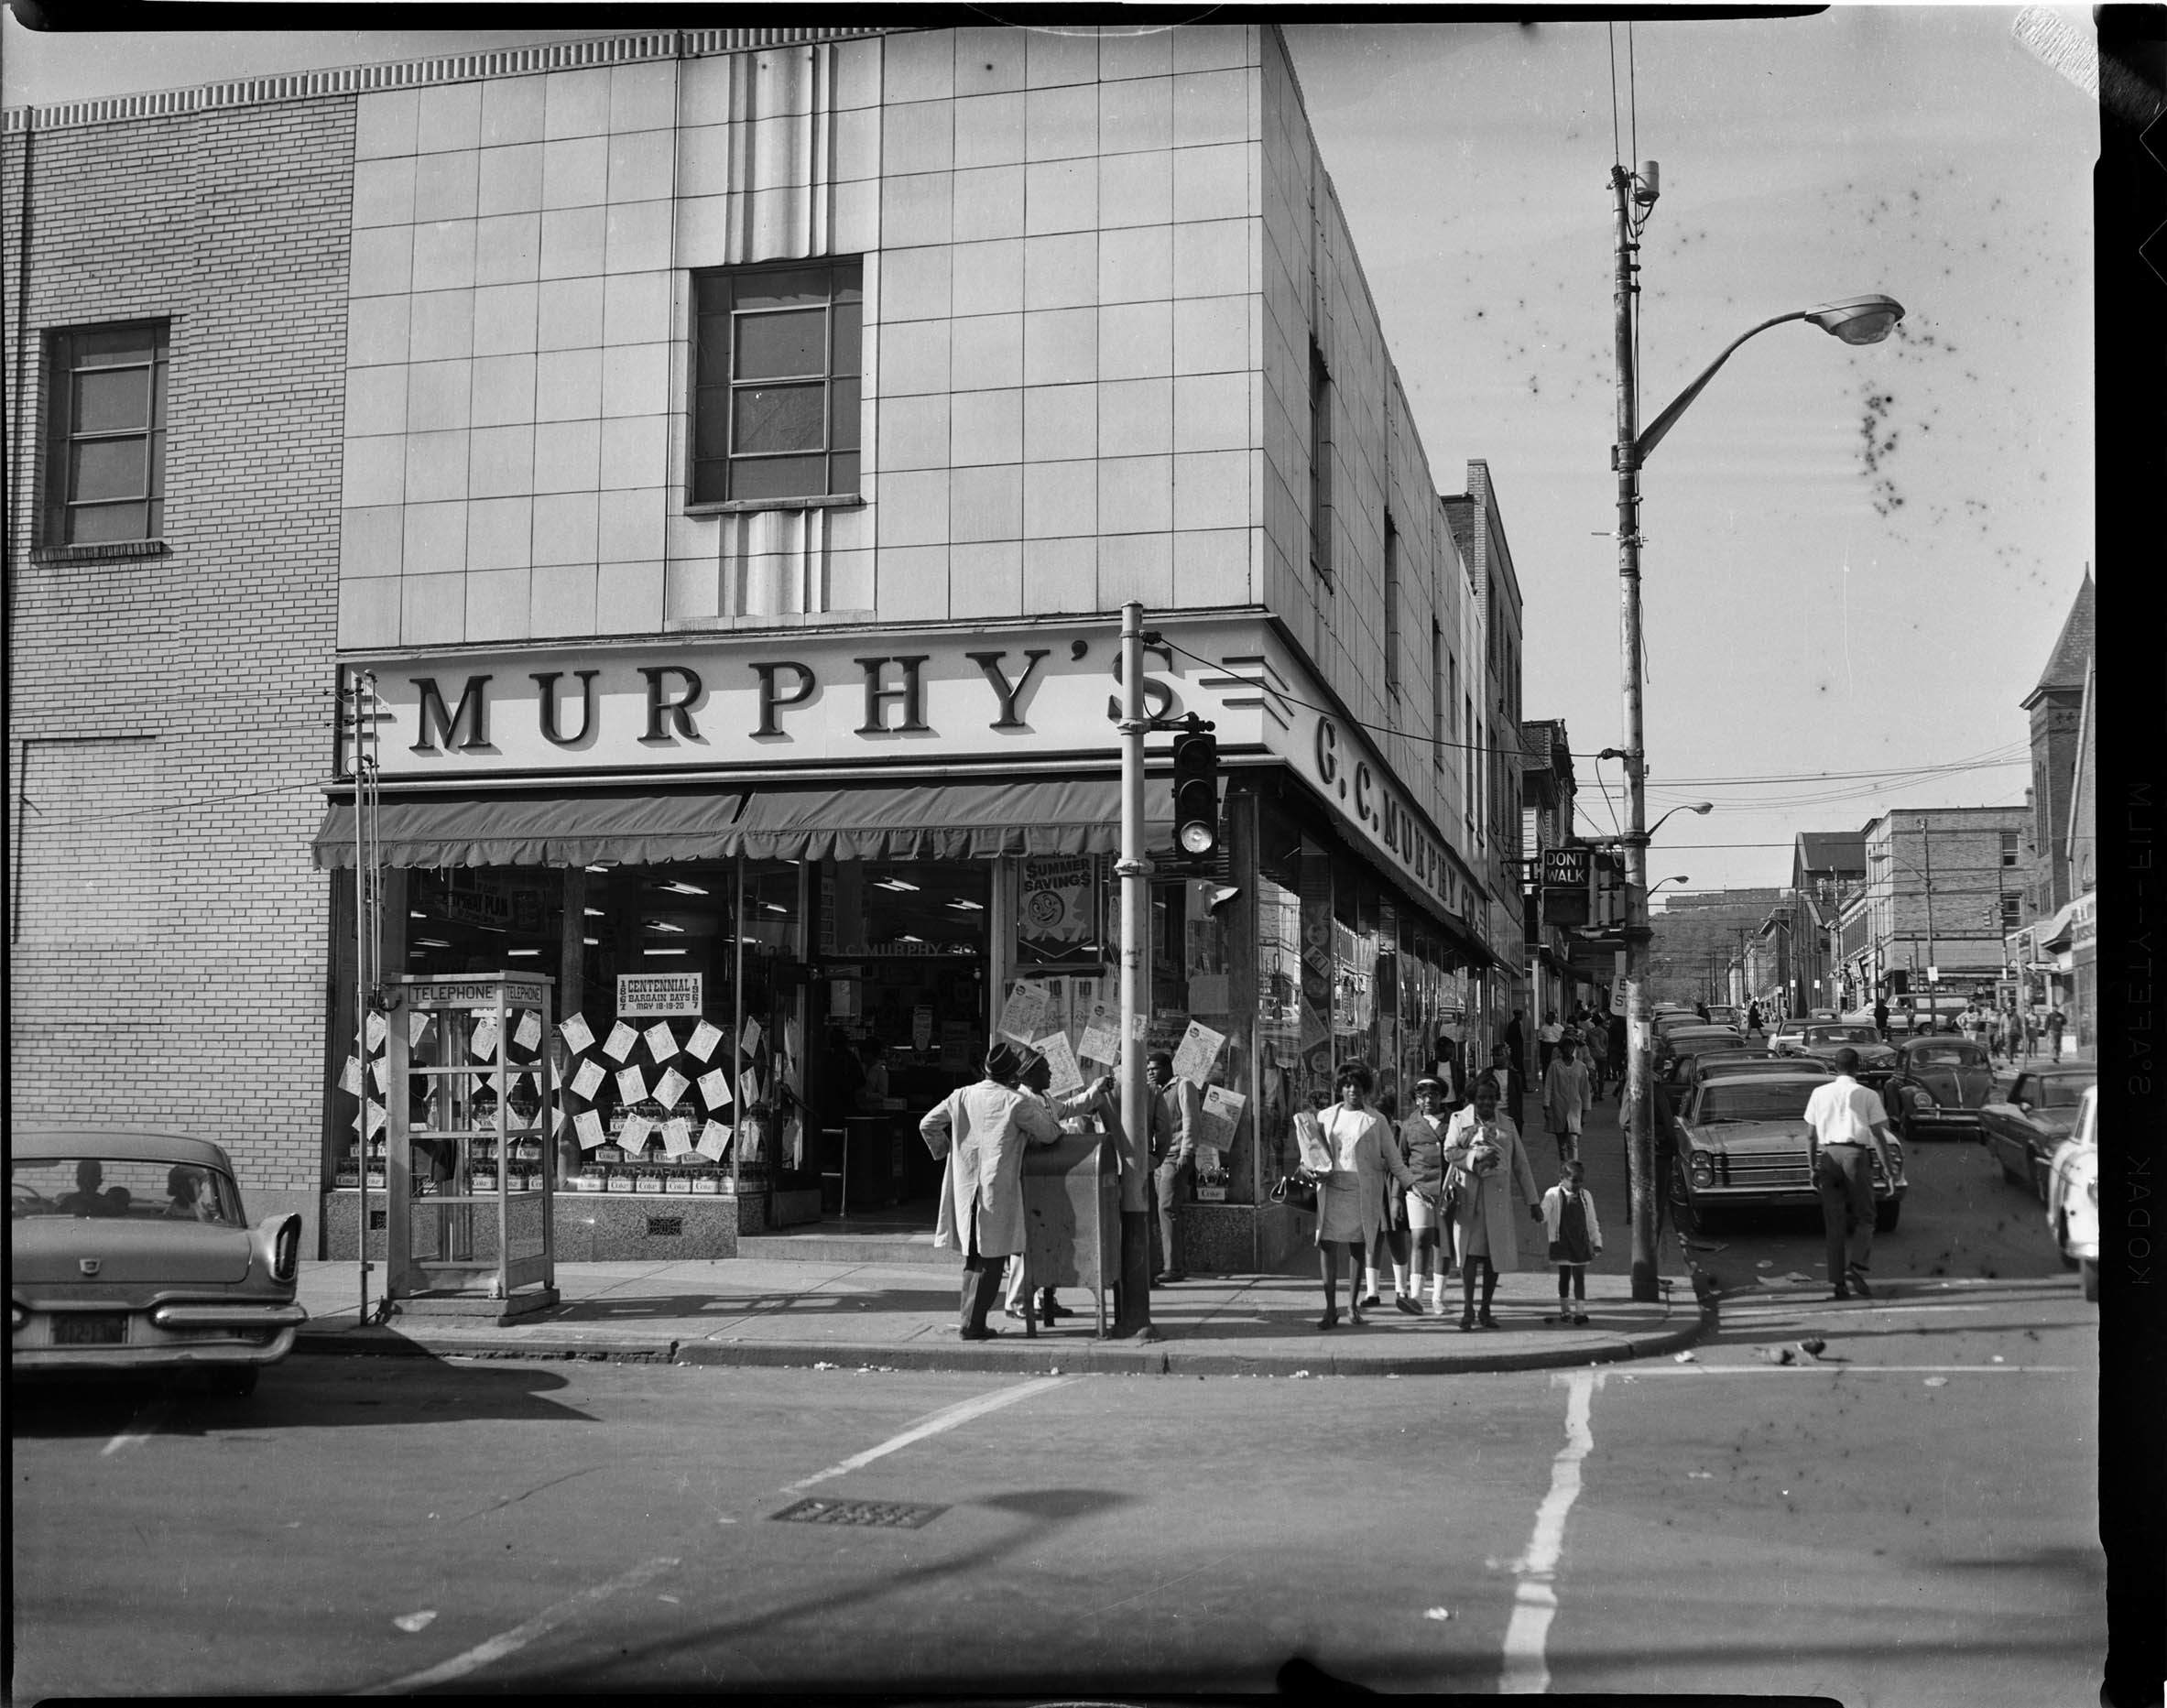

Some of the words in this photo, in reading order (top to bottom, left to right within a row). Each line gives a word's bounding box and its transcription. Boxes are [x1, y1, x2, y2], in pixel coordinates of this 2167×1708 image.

[408, 639, 1174, 751] MURPHY'S
[1546, 852, 1584, 866] DONT
[1546, 868, 1585, 883] WALK
[866, 942, 943, 955] MURPHY
[412, 985, 494, 1001] TELEPHONE
[506, 985, 541, 1001] TELEPHONE
[628, 978, 690, 993] CENTENNIAL
[628, 994, 667, 1002] BARGAIN
[670, 994, 691, 1002] DAYS
[636, 1002, 654, 1010] MAY
